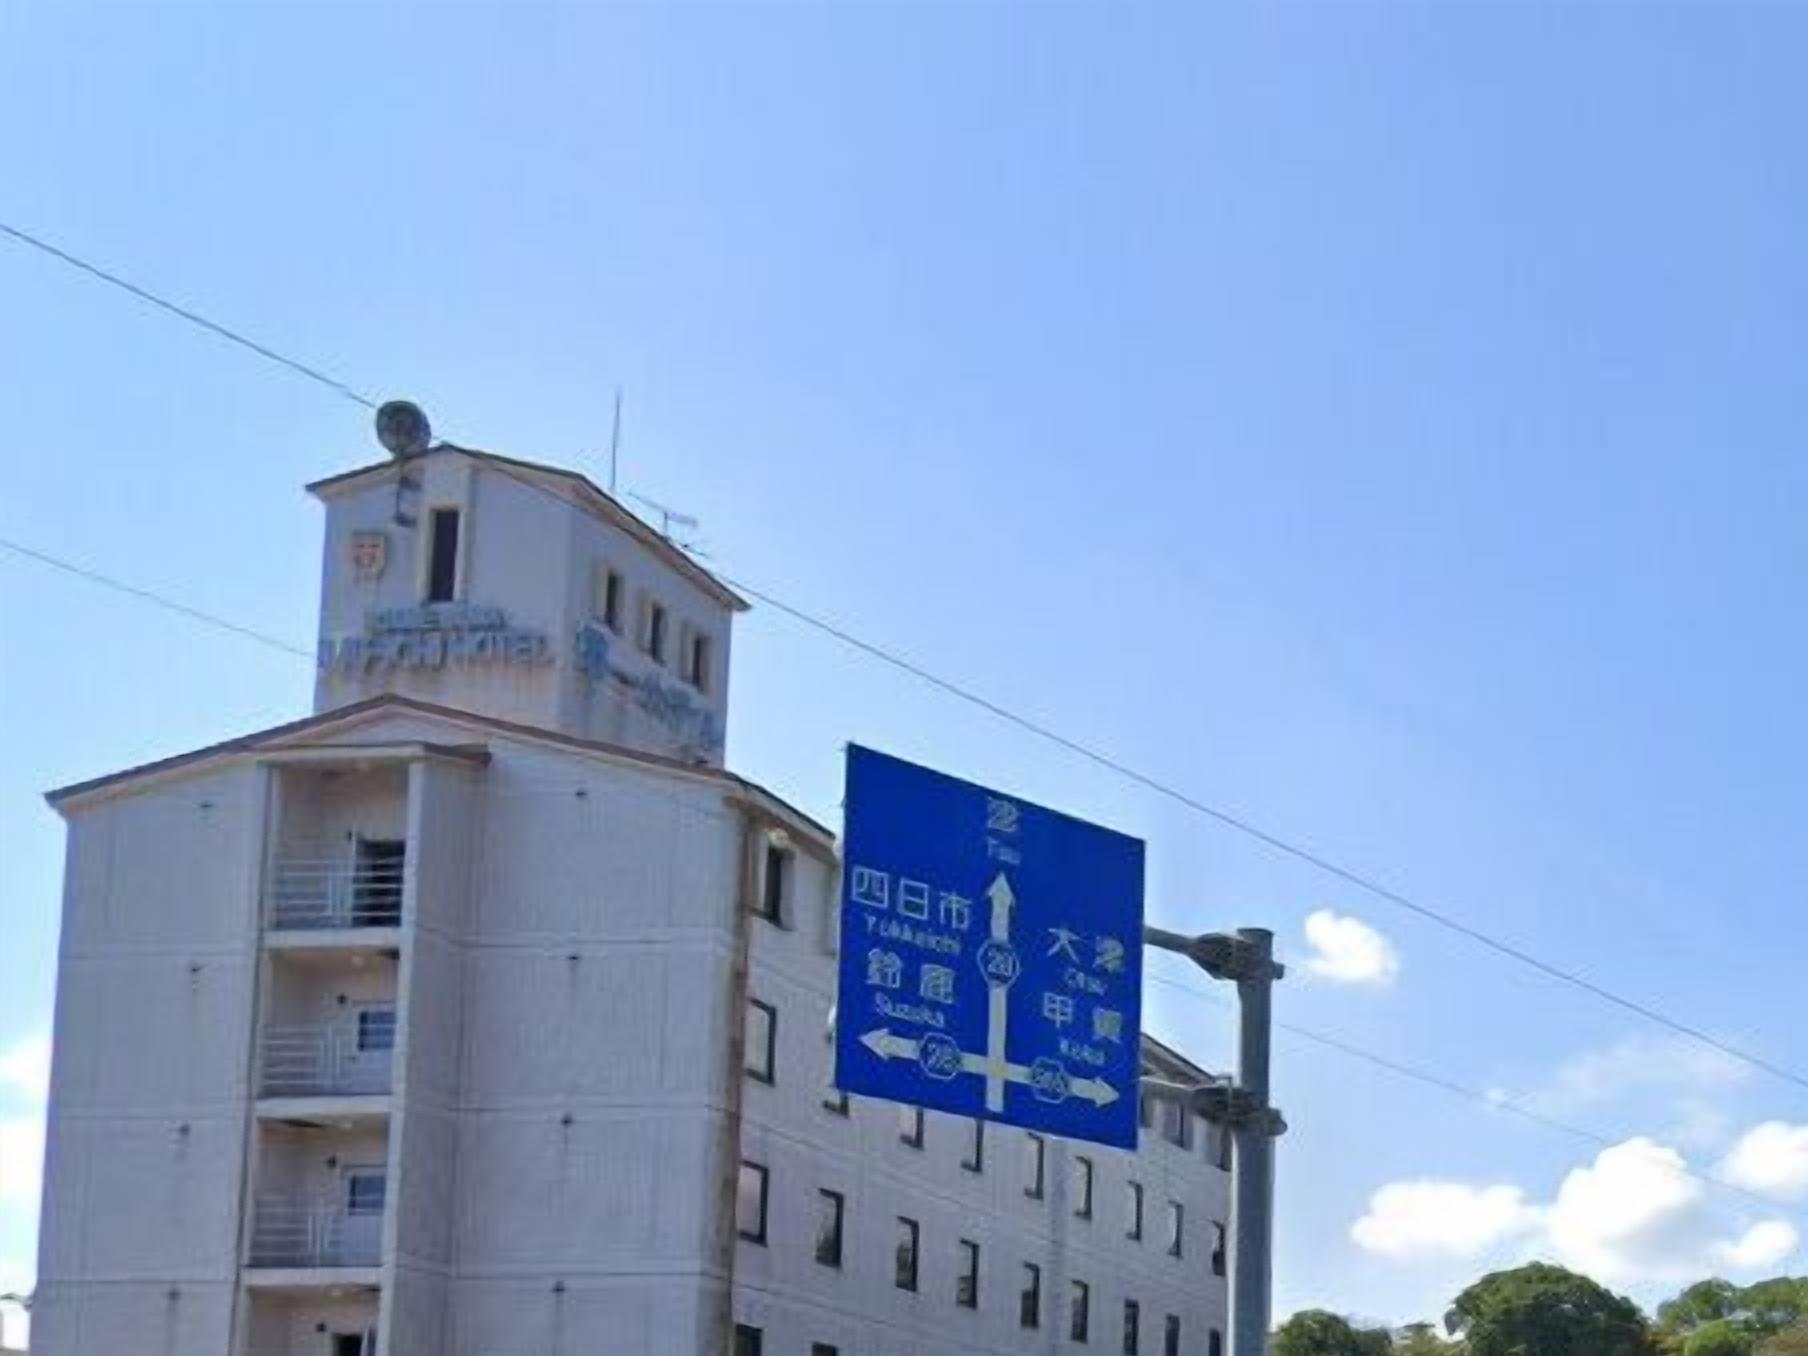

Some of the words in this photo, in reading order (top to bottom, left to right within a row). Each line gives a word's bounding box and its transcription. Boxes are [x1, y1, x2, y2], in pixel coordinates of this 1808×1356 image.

[851, 866, 972, 931] 四日市
[866, 948, 956, 1004] 鈴鹿
